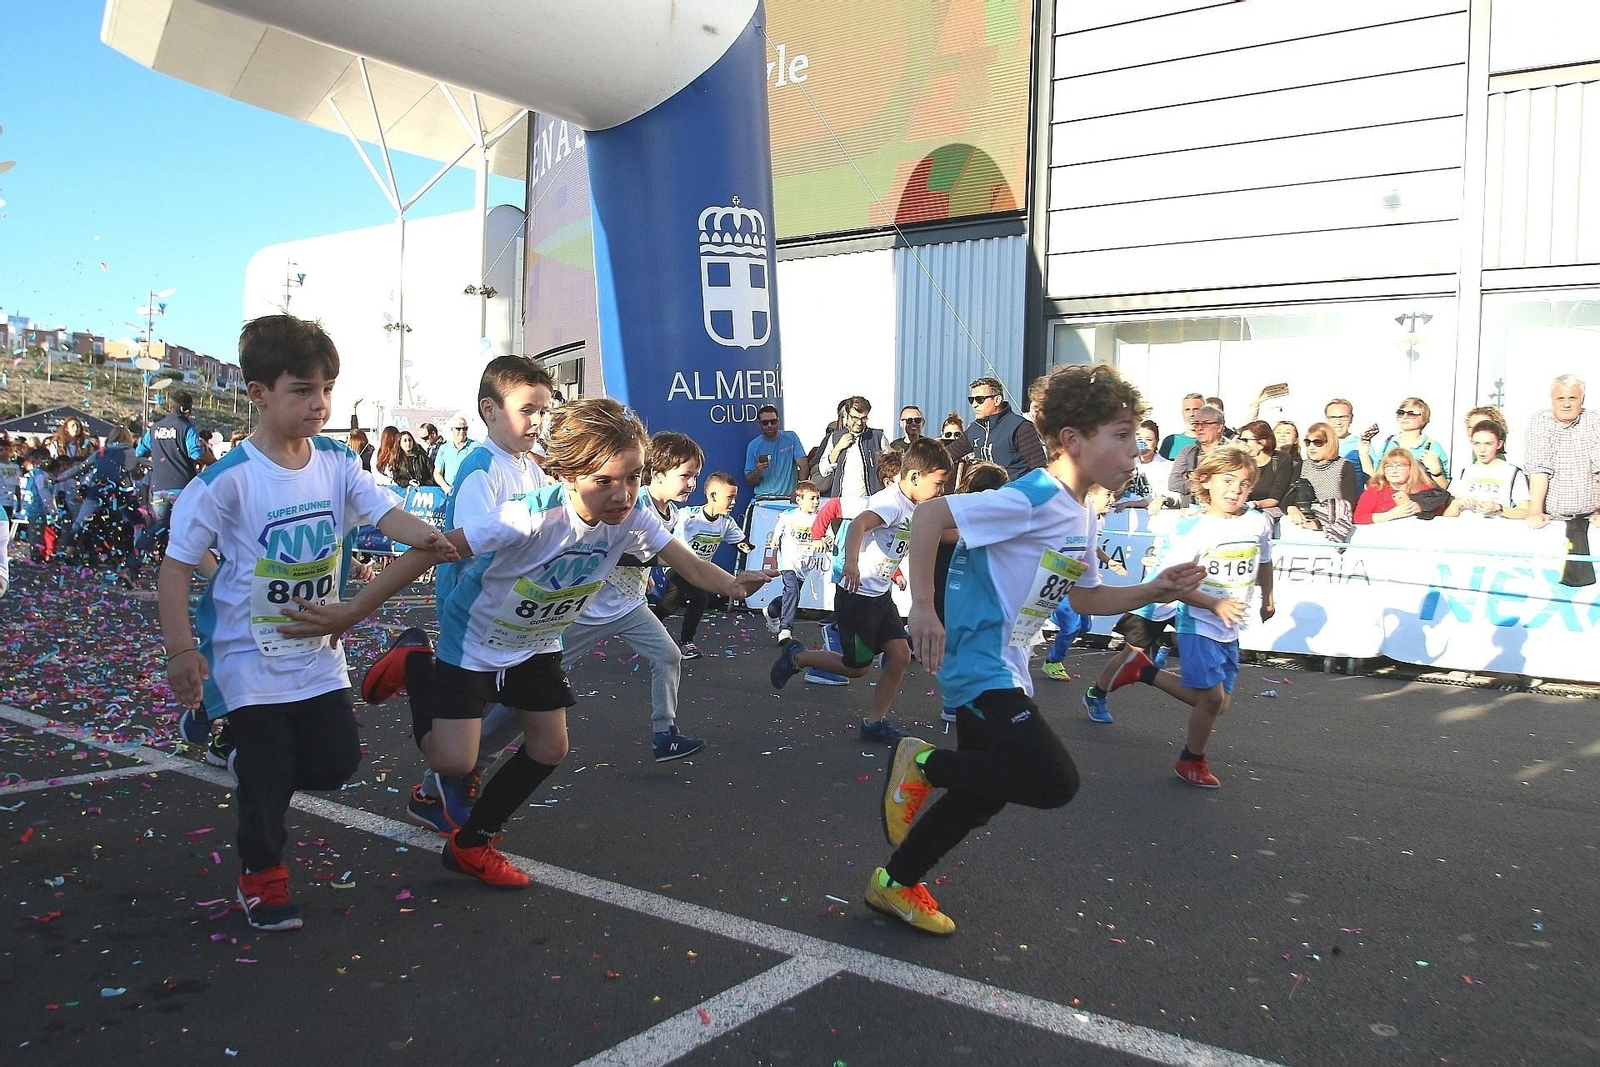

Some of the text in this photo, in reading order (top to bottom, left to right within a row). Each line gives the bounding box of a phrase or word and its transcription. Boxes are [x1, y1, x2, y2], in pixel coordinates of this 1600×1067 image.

[710, 404, 776, 424] CIUD
[267, 500, 331, 521] SUPER RUNNER
[691, 540, 718, 554] 8420
[267, 572, 336, 605] 800
[515, 594, 589, 619] 8161
[530, 615, 564, 626] GONZALO
